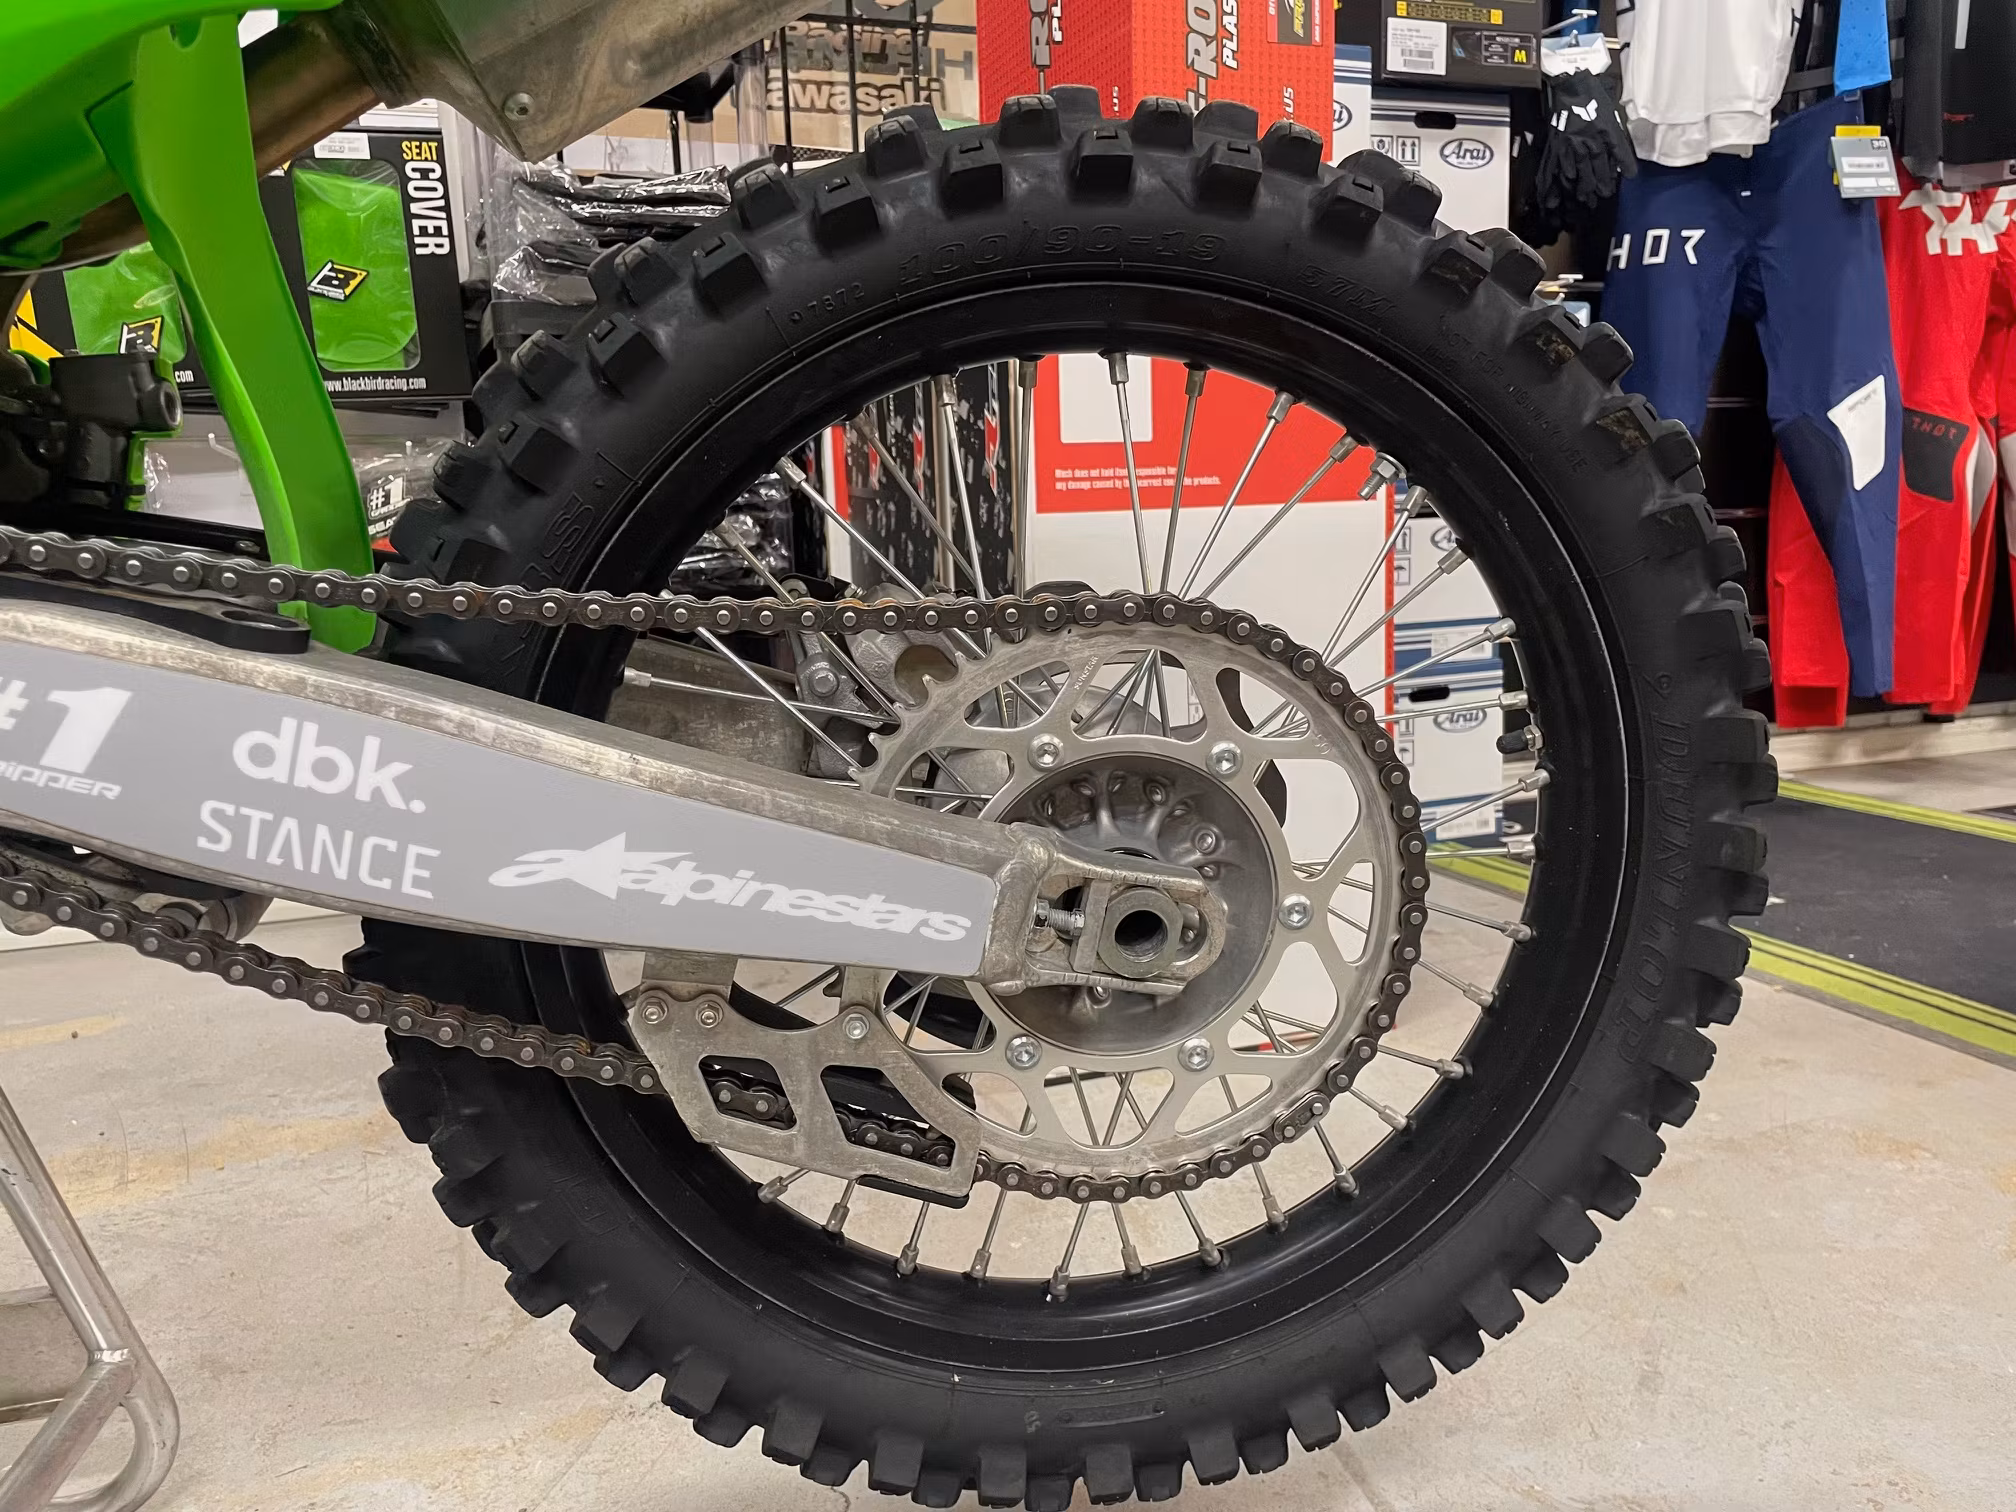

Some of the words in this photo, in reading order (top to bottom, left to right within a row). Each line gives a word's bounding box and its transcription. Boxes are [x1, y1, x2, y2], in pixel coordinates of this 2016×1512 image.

[402, 140, 438, 161] SEAT
[1446, 141, 1488, 160] Arai
[404, 161, 451, 255] COVER
[897, 219, 1228, 286] 100/90-19
[232, 716, 427, 814] dbk.
[196, 800, 442, 900] STANCE
[1617, 711, 1695, 1064] DUNLOP
[612, 856, 973, 943] alpinestars
